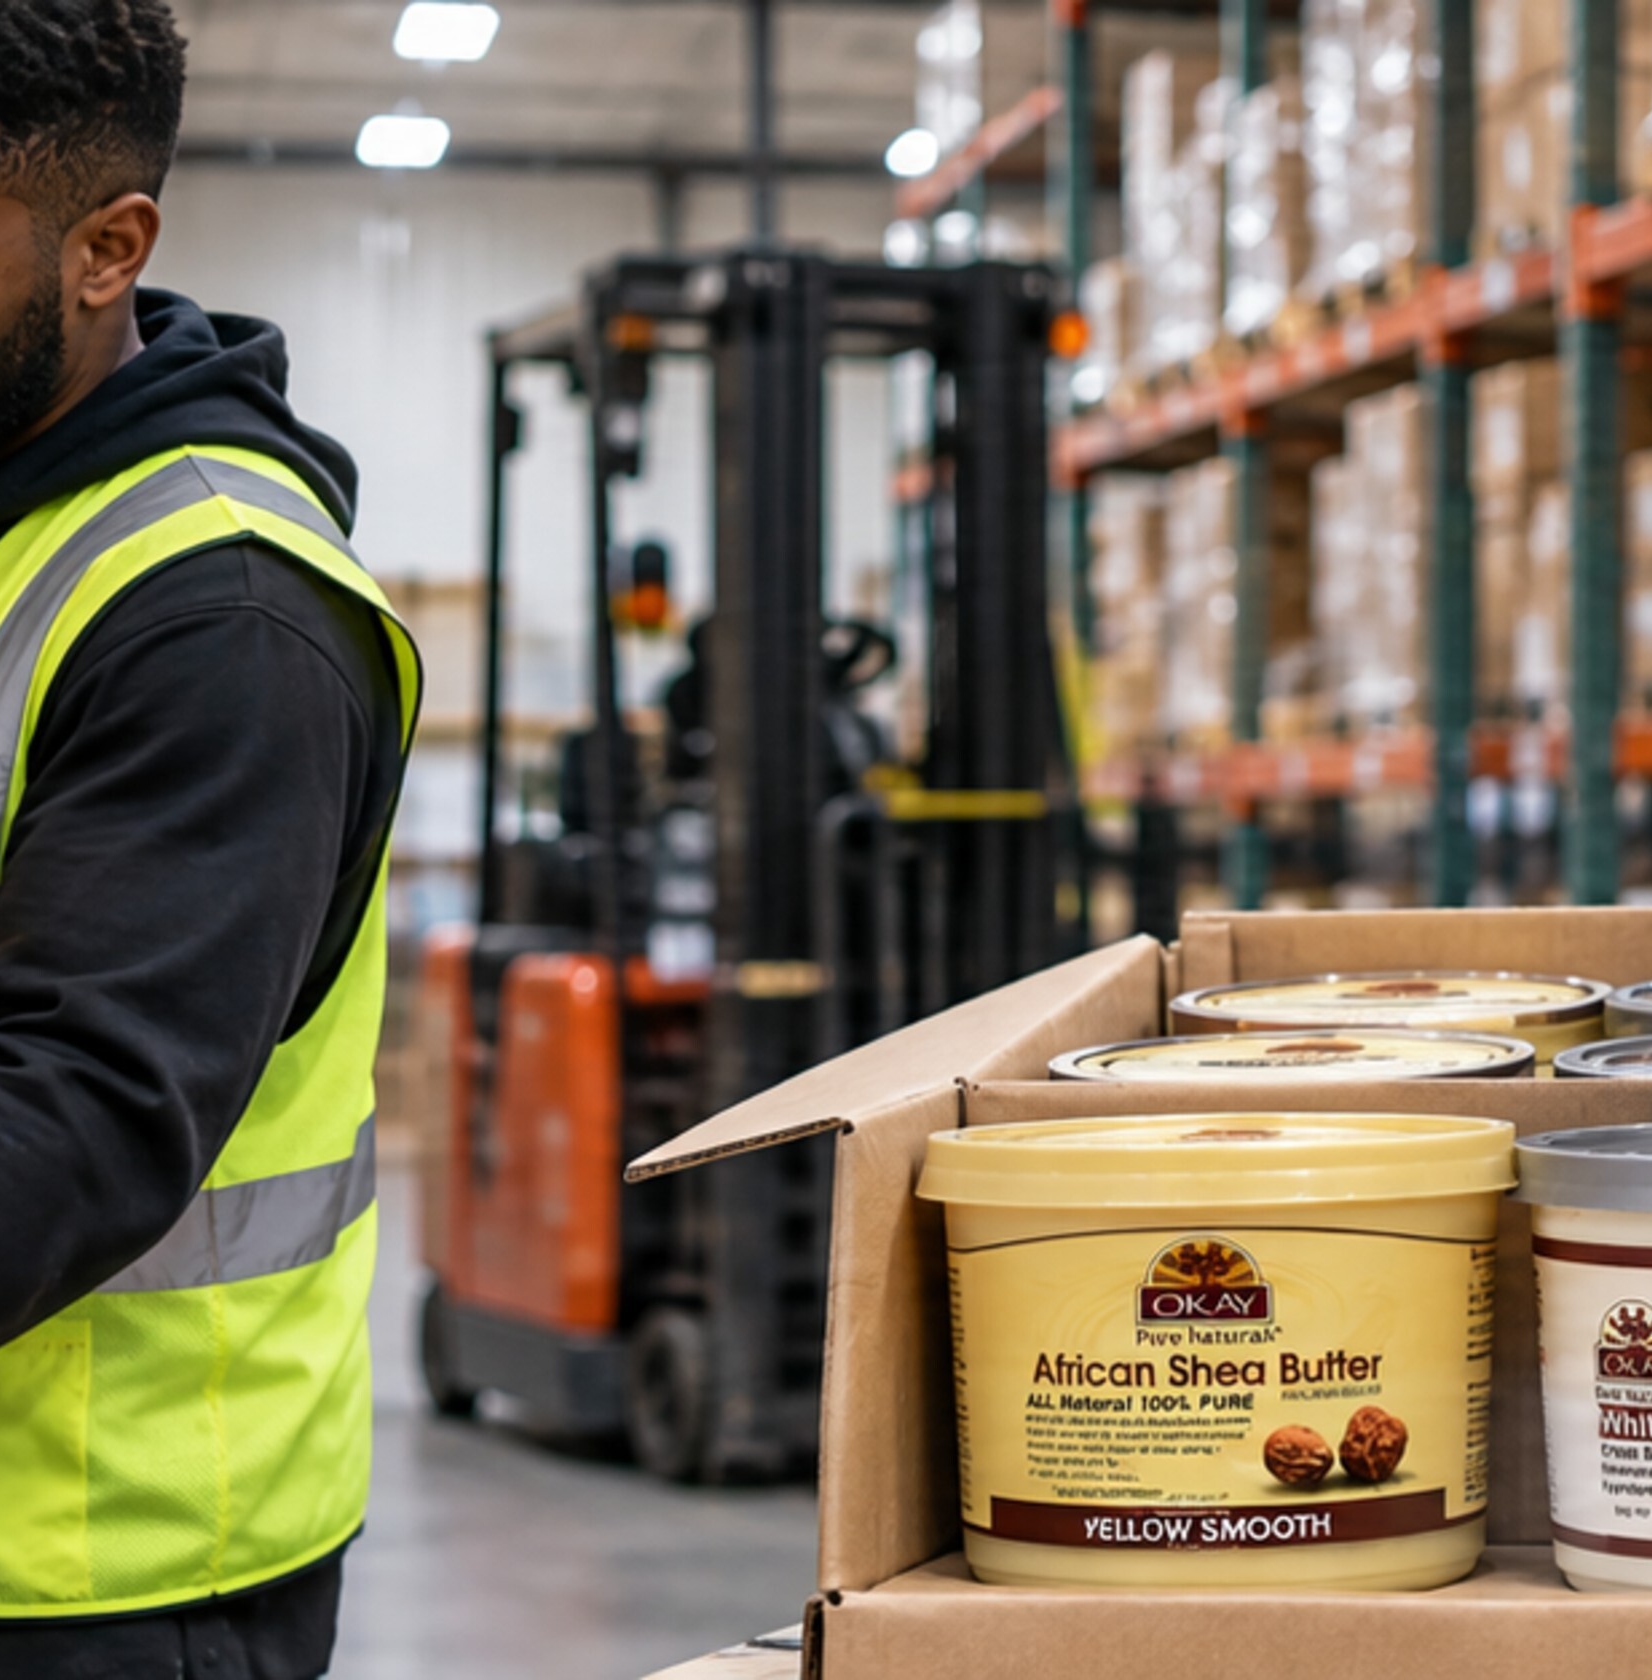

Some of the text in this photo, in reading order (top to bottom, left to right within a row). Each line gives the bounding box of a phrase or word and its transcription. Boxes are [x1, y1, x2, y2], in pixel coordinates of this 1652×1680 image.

[1152, 1293, 1257, 1317] OKAY
[1032, 1349, 1383, 1388] African Shea Butter
[1199, 1392, 1254, 1411] PURE
[1084, 1512, 1332, 1542] YELLOW SMOOTH
